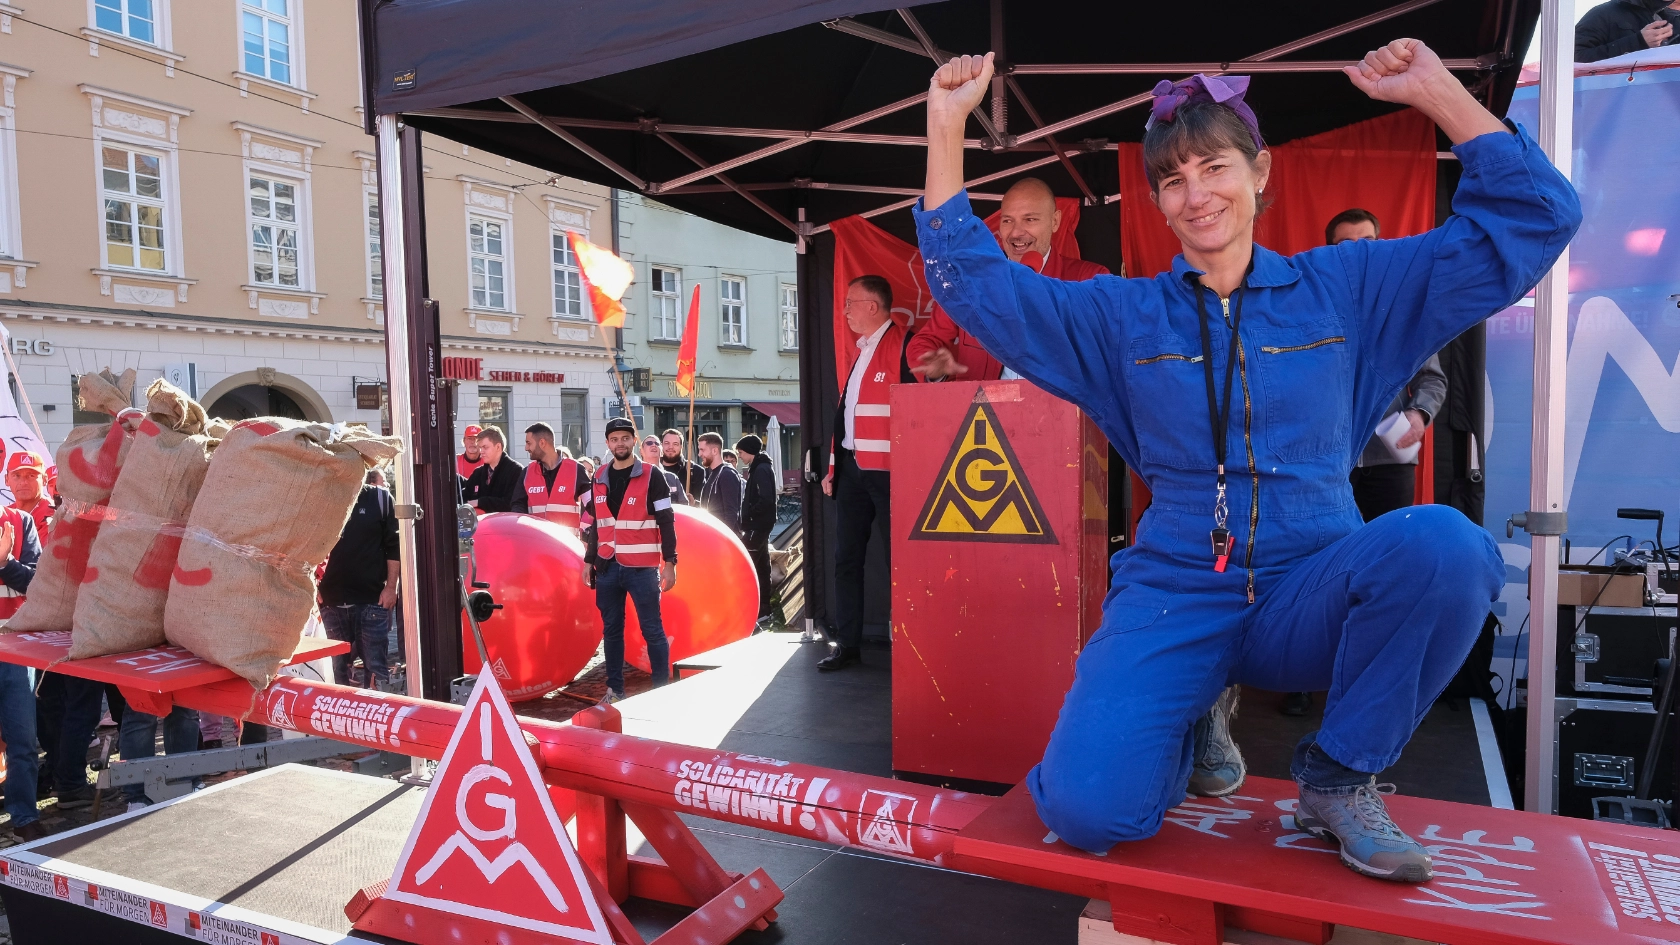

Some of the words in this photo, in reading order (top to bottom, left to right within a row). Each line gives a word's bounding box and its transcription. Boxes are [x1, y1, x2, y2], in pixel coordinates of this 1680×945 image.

[1488, 315, 1511, 335] TE
[8, 337, 55, 357] RG
[442, 356, 484, 381] ONDE
[489, 370, 521, 382] SEHEN
[524, 372, 531, 382] &
[533, 370, 565, 383] HÖREN
[873, 371, 886, 383] 8!
[528, 486, 545, 494] GEBT
[558, 485, 566, 493] 8!
[627, 496, 637, 506] 8!
[503, 680, 552, 697] halten
[312, 694, 395, 724] SOLIDARITÄT
[677, 759, 805, 798] SOLIDARITÄT
[9, 862, 53, 882] MITEINANDER
[10, 873, 23, 888] FÜR
[22, 877, 55, 896] MORGEN
[1594, 850, 1662, 922] SOLIDARITÄT
[99, 886, 149, 909] MITEINANDER
[100, 899, 116, 914] FÜR
[116, 903, 150, 924] MORGEN
[201, 914, 259, 941] MITEINANDER
[202, 927, 220, 944] FÜR
